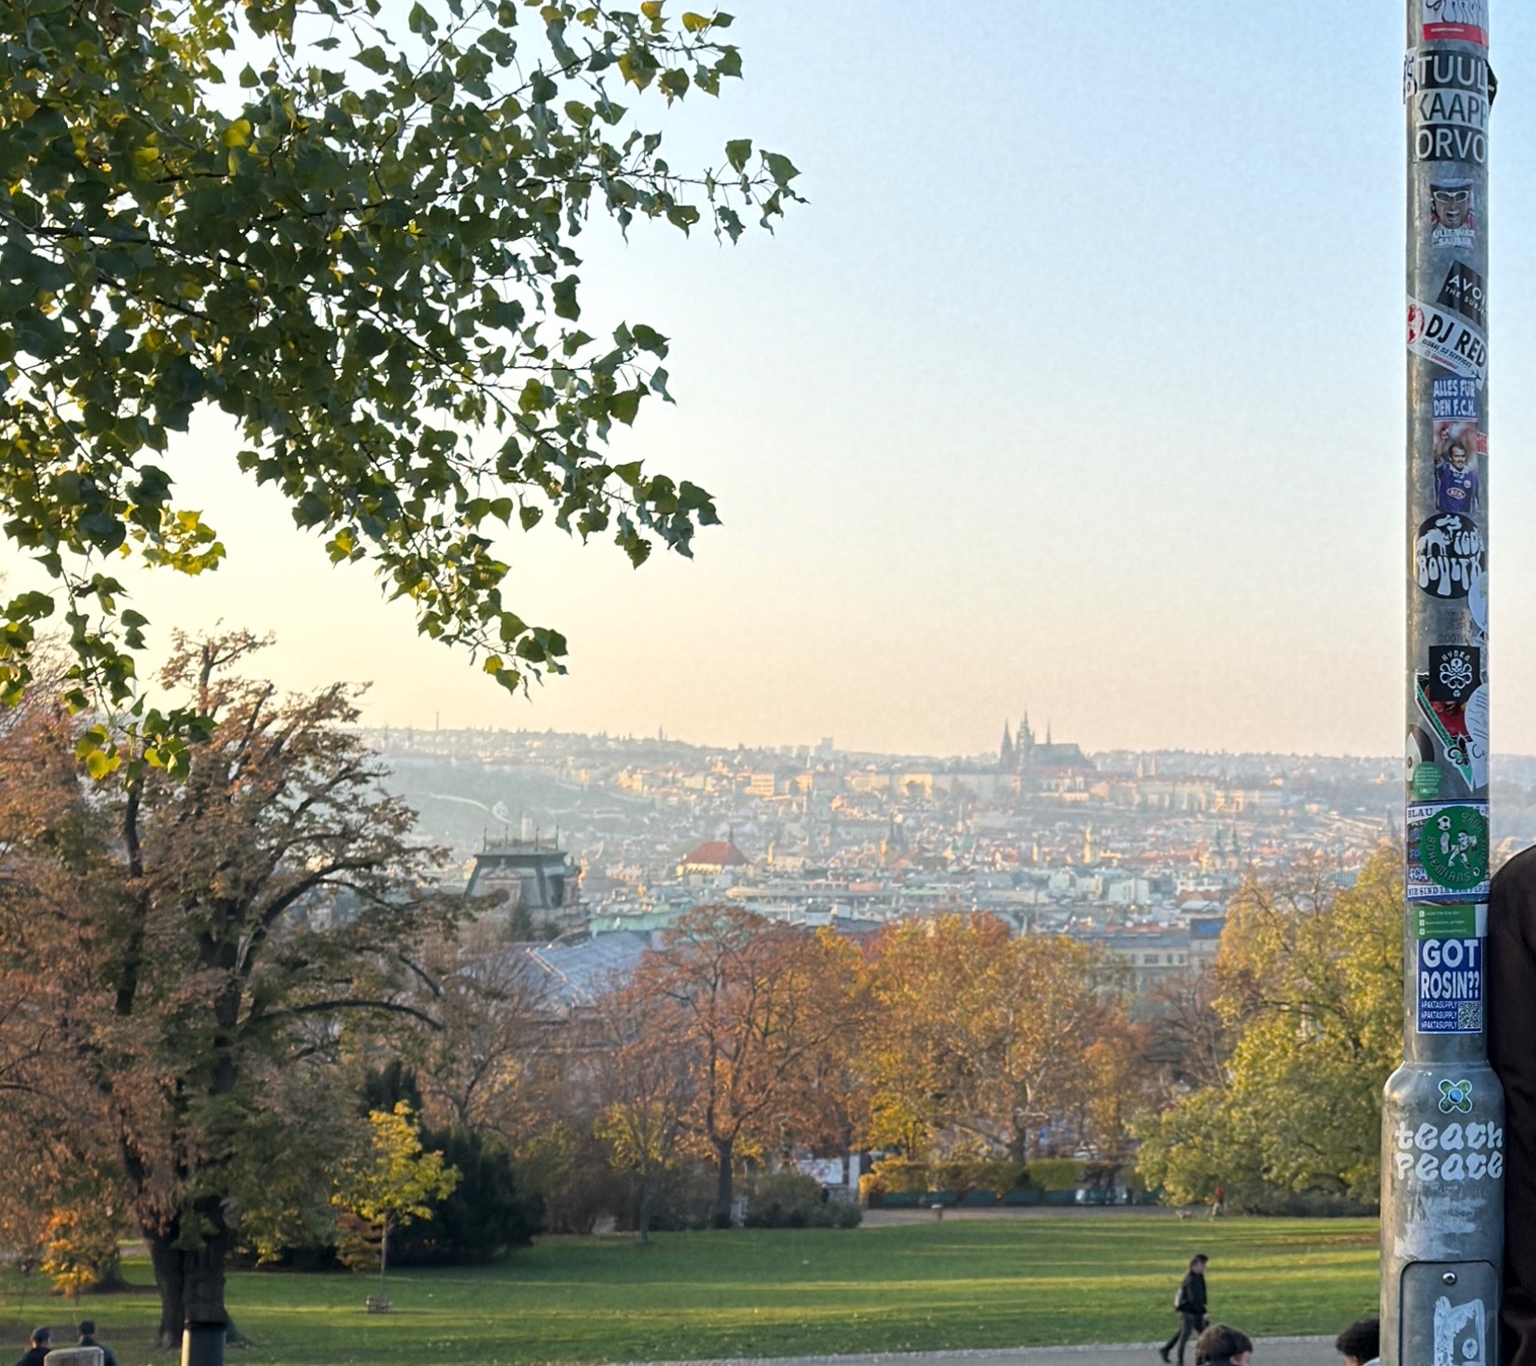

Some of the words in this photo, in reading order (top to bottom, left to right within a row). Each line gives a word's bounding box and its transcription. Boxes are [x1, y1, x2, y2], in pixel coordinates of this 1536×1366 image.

[1444, 285, 1461, 299] THE
[1425, 313, 1455, 344] DJ
[1453, 328, 1487, 368] RED
[1433, 380, 1458, 398] ALLES
[1433, 399, 1452, 417] DEN
[1426, 835, 1472, 884] BOHEMIANS
[1422, 939, 1479, 968] GOT
[1420, 970, 1480, 999] ROSIN??
[1394, 1120, 1503, 1151] teach
